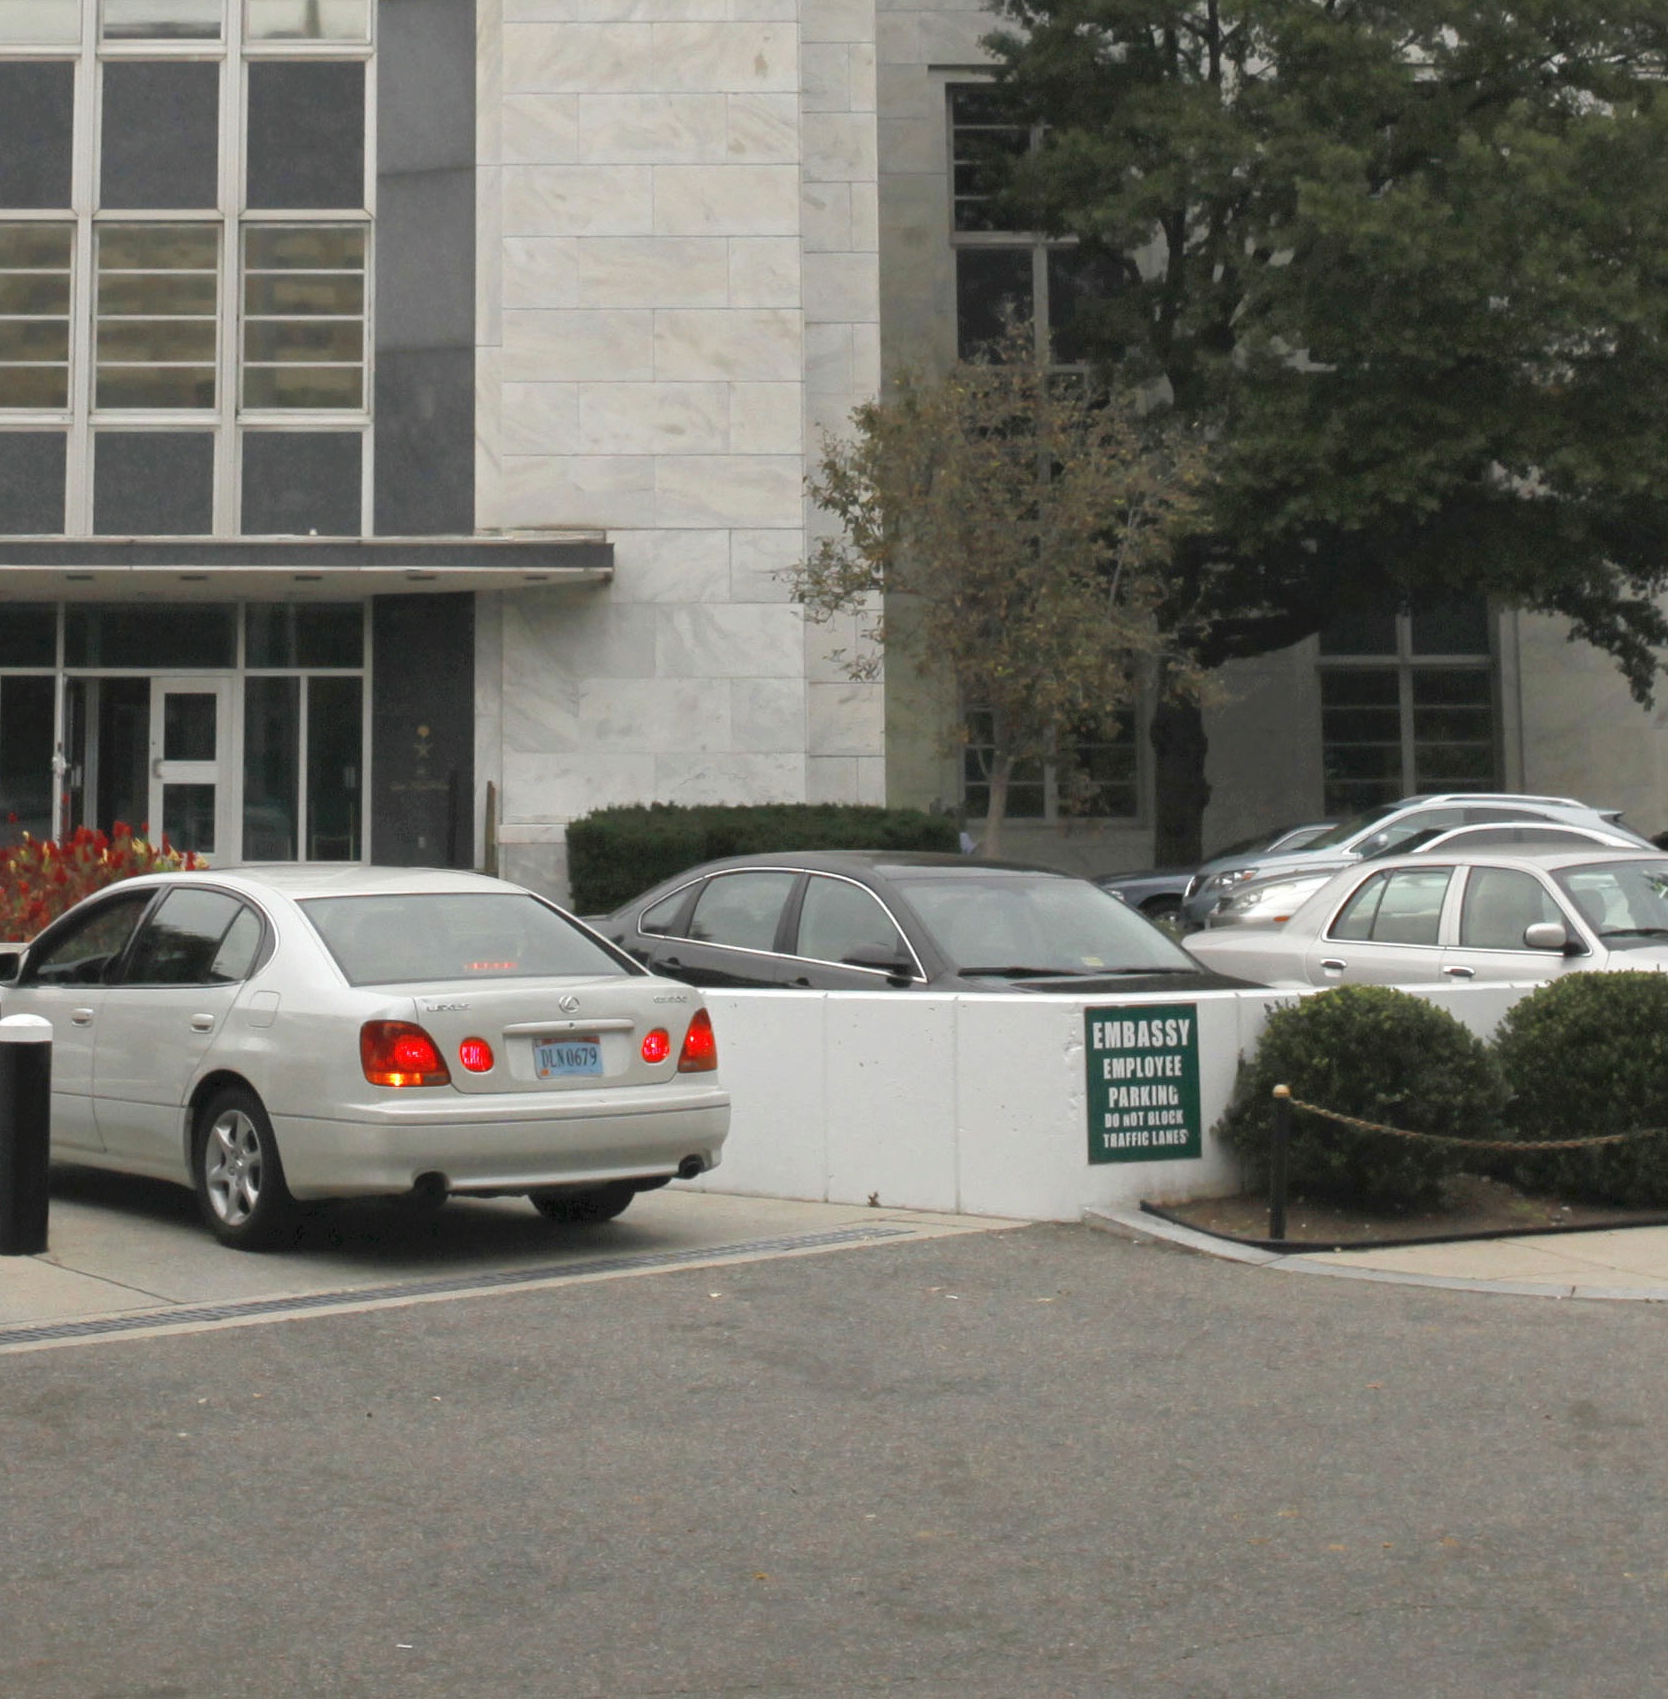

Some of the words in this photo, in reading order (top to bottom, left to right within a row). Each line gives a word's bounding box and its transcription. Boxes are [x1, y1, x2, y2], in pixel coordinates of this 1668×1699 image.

[1092, 1019, 1190, 1049] EMBASSY
[1103, 1055, 1182, 1079] EMPLOYEE
[1108, 1085, 1179, 1108] PARKING
[1104, 1113, 1120, 1128] DO
[1148, 1109, 1183, 1126] BLOCK
[1103, 1131, 1149, 1148] TRAFFIC
[1152, 1129, 1188, 1146] LANES
